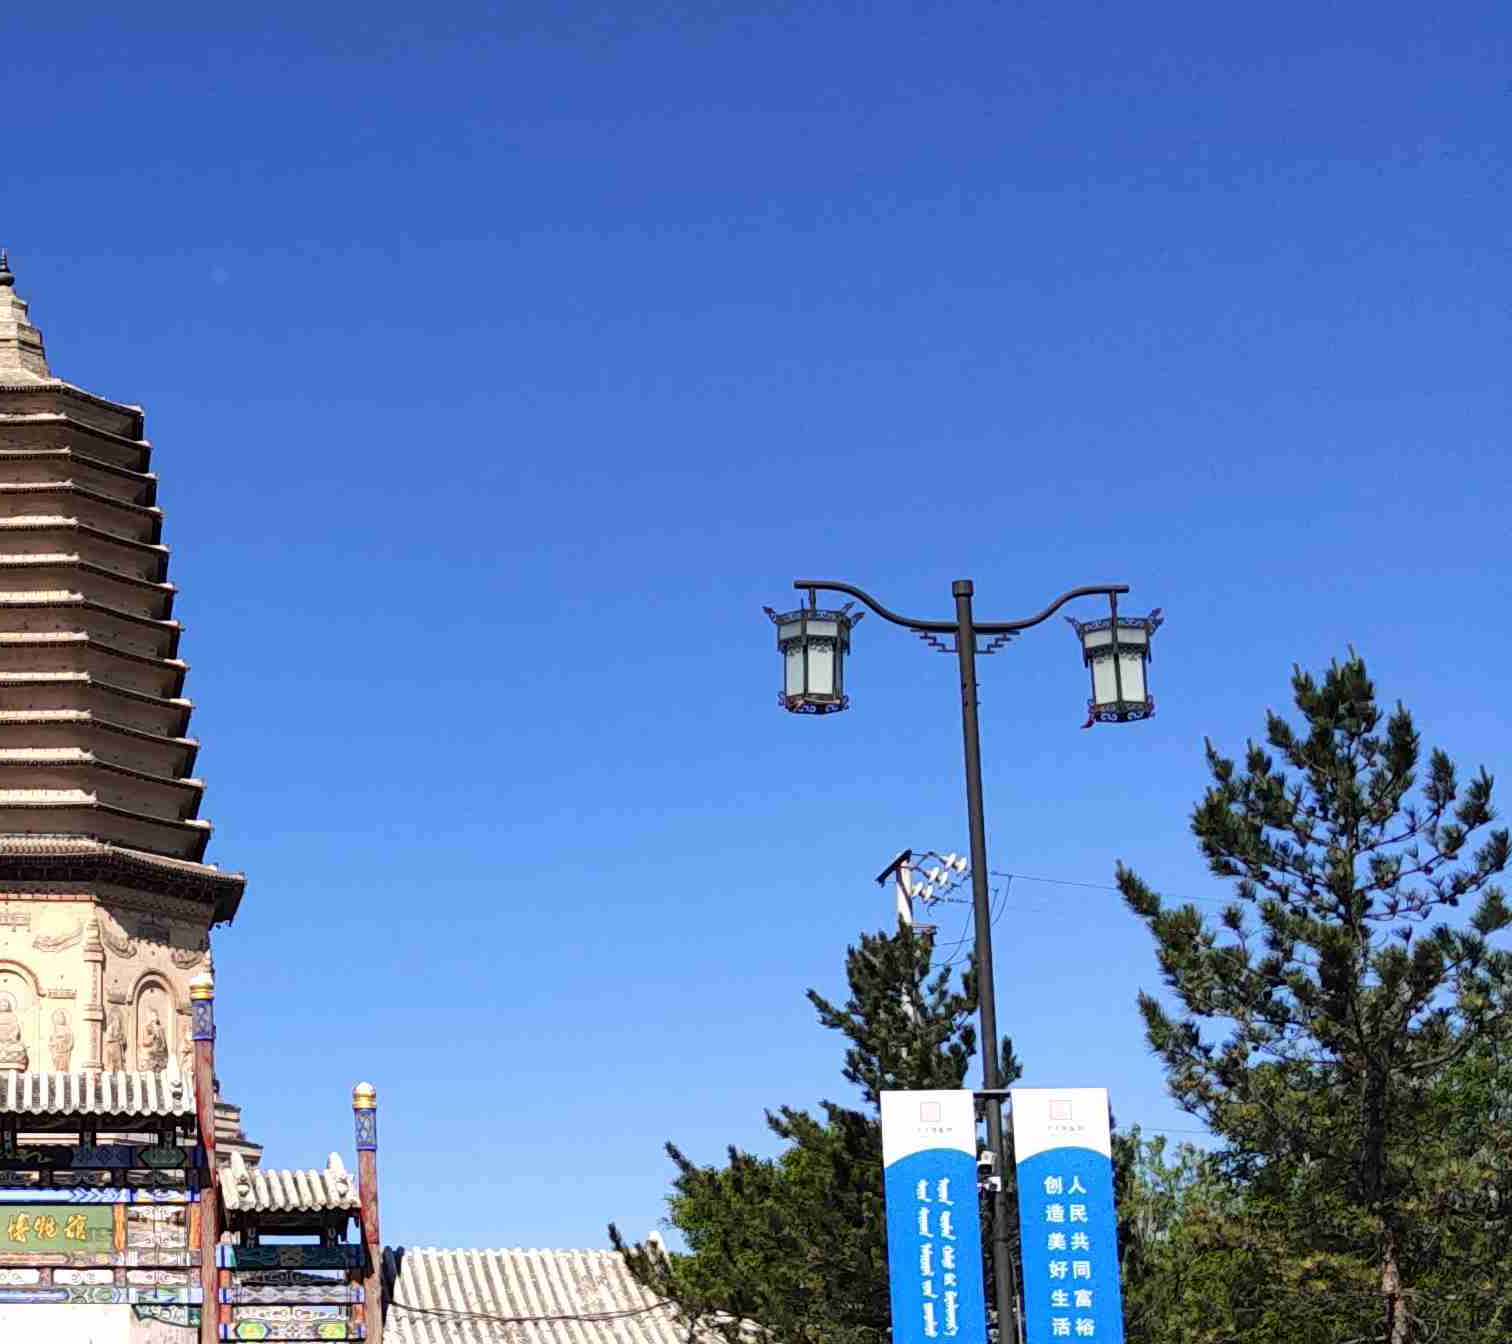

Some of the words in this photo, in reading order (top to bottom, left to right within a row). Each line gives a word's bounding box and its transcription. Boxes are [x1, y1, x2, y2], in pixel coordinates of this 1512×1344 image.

[1044, 1176, 1071, 1337] 创造美好生活
[1067, 1176, 1095, 1337] 人民共同富裕
